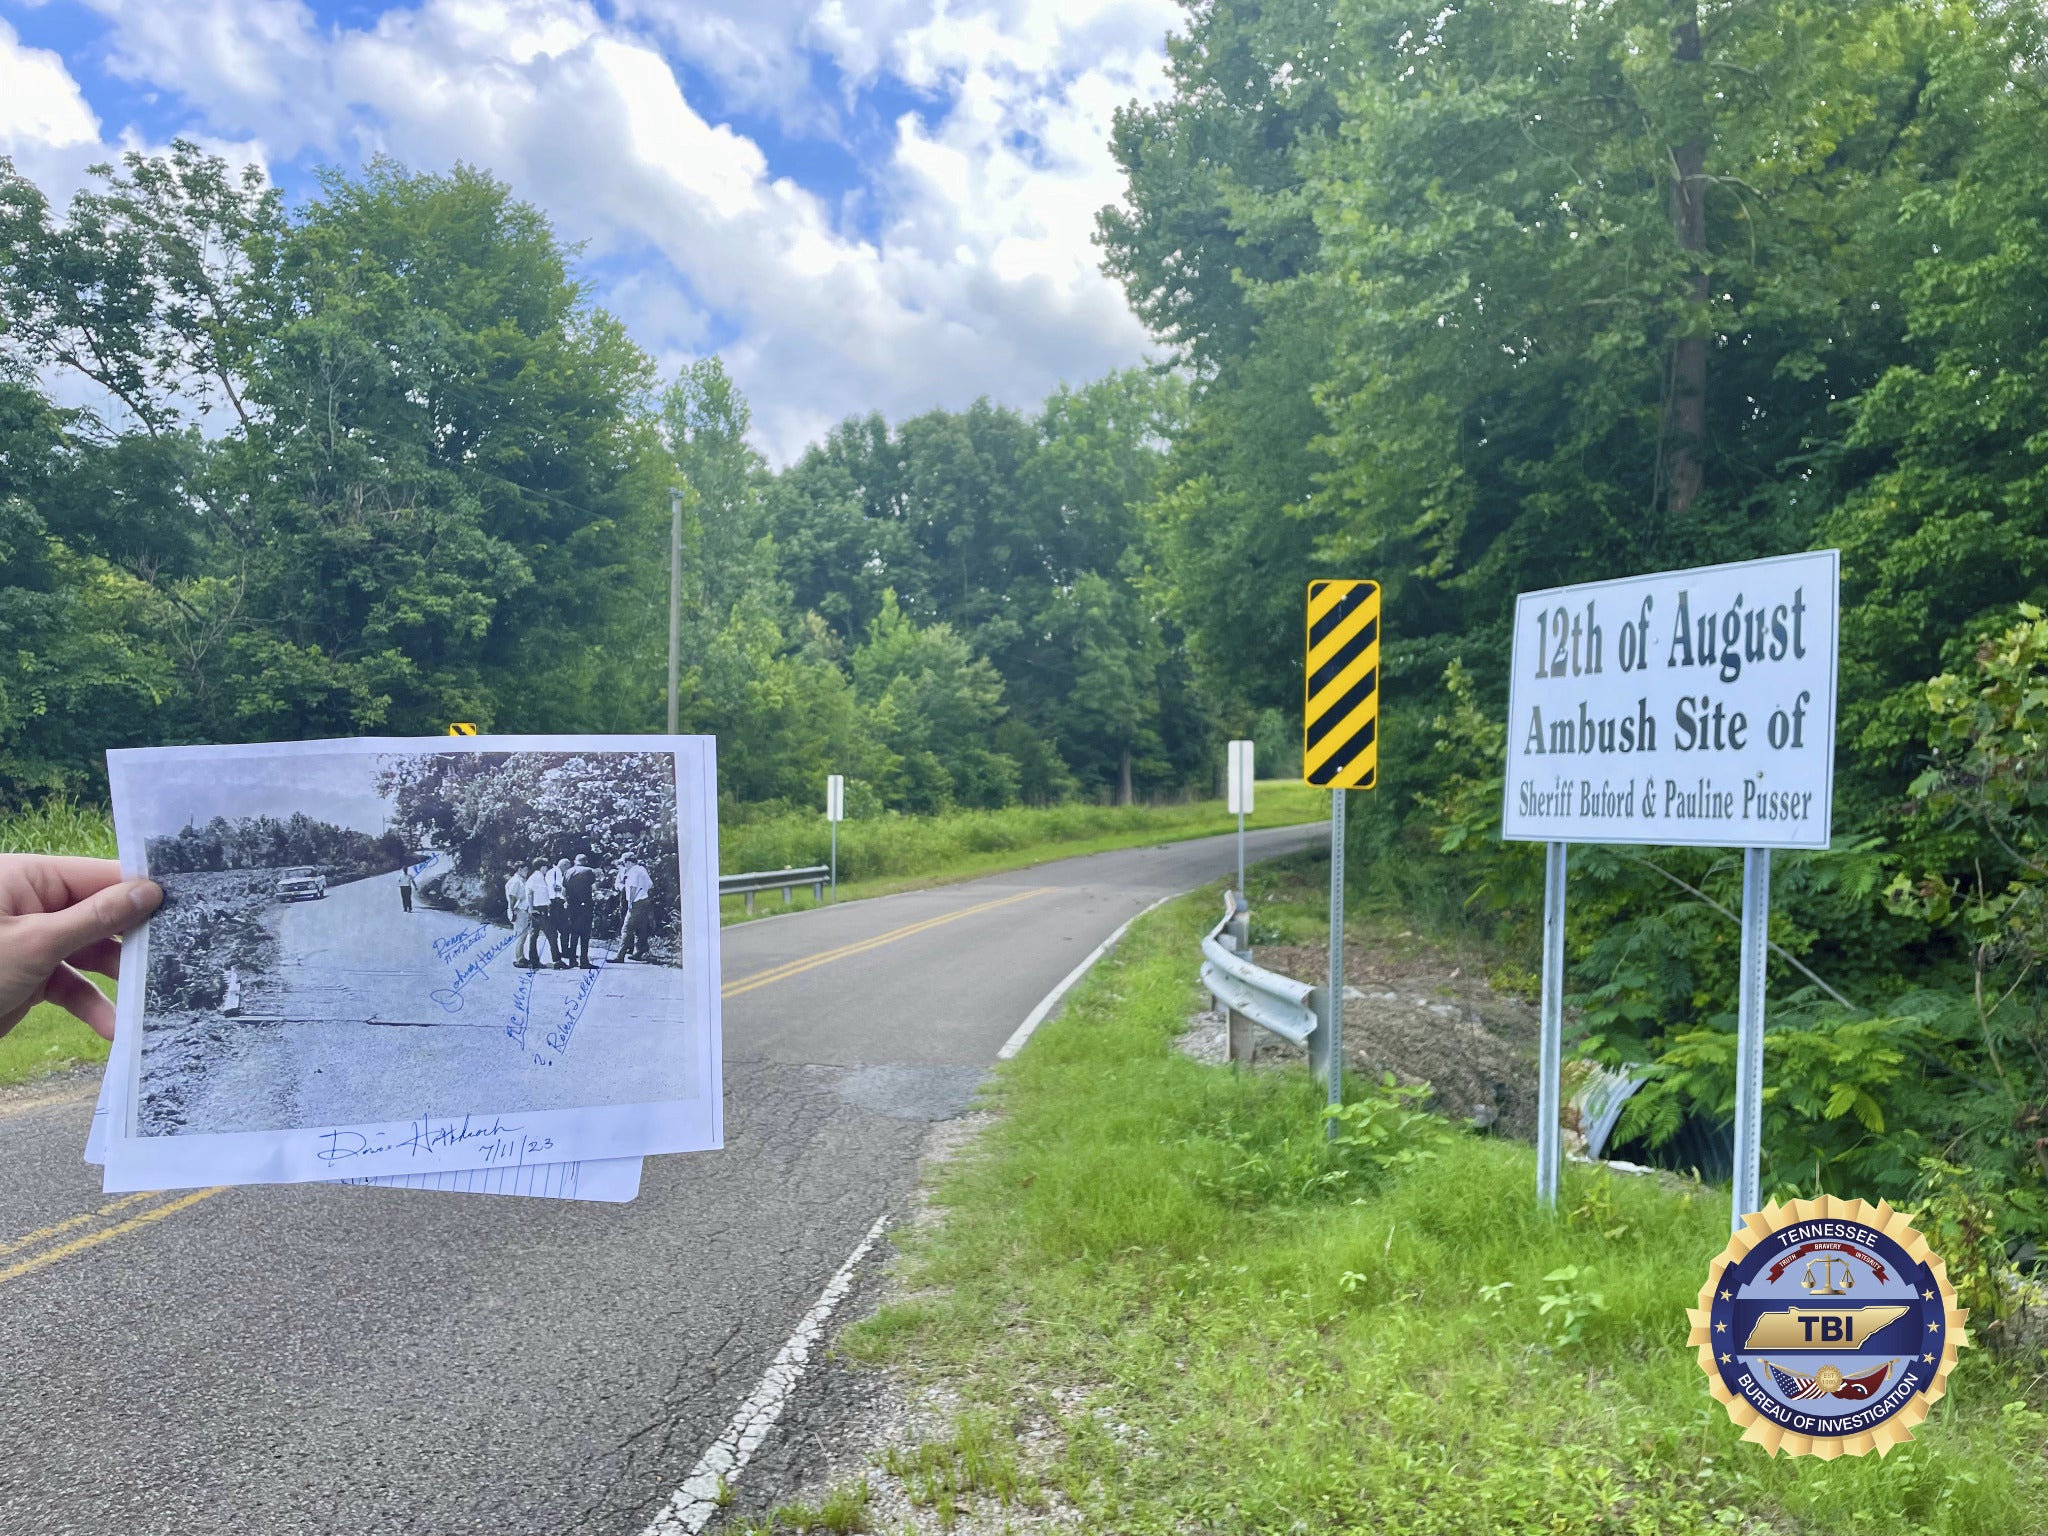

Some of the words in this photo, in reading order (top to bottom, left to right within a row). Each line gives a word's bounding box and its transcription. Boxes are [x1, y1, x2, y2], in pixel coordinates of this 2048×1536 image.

[1535, 599, 1603, 680] 12th
[1619, 594, 1654, 673] of
[1667, 586, 1806, 683] August
[1524, 698, 1657, 755] Ambush
[1674, 695, 1747, 752] Site
[1768, 690, 1811, 750] of
[1519, 776, 1574, 819] Sheriff
[1580, 778, 1634, 819] Buford
[1642, 780, 1657, 819] &
[1664, 778, 1733, 820] Pauline
[1742, 778, 1812, 821] Pusser
[479, 1134, 554, 1165] 7/11/23
